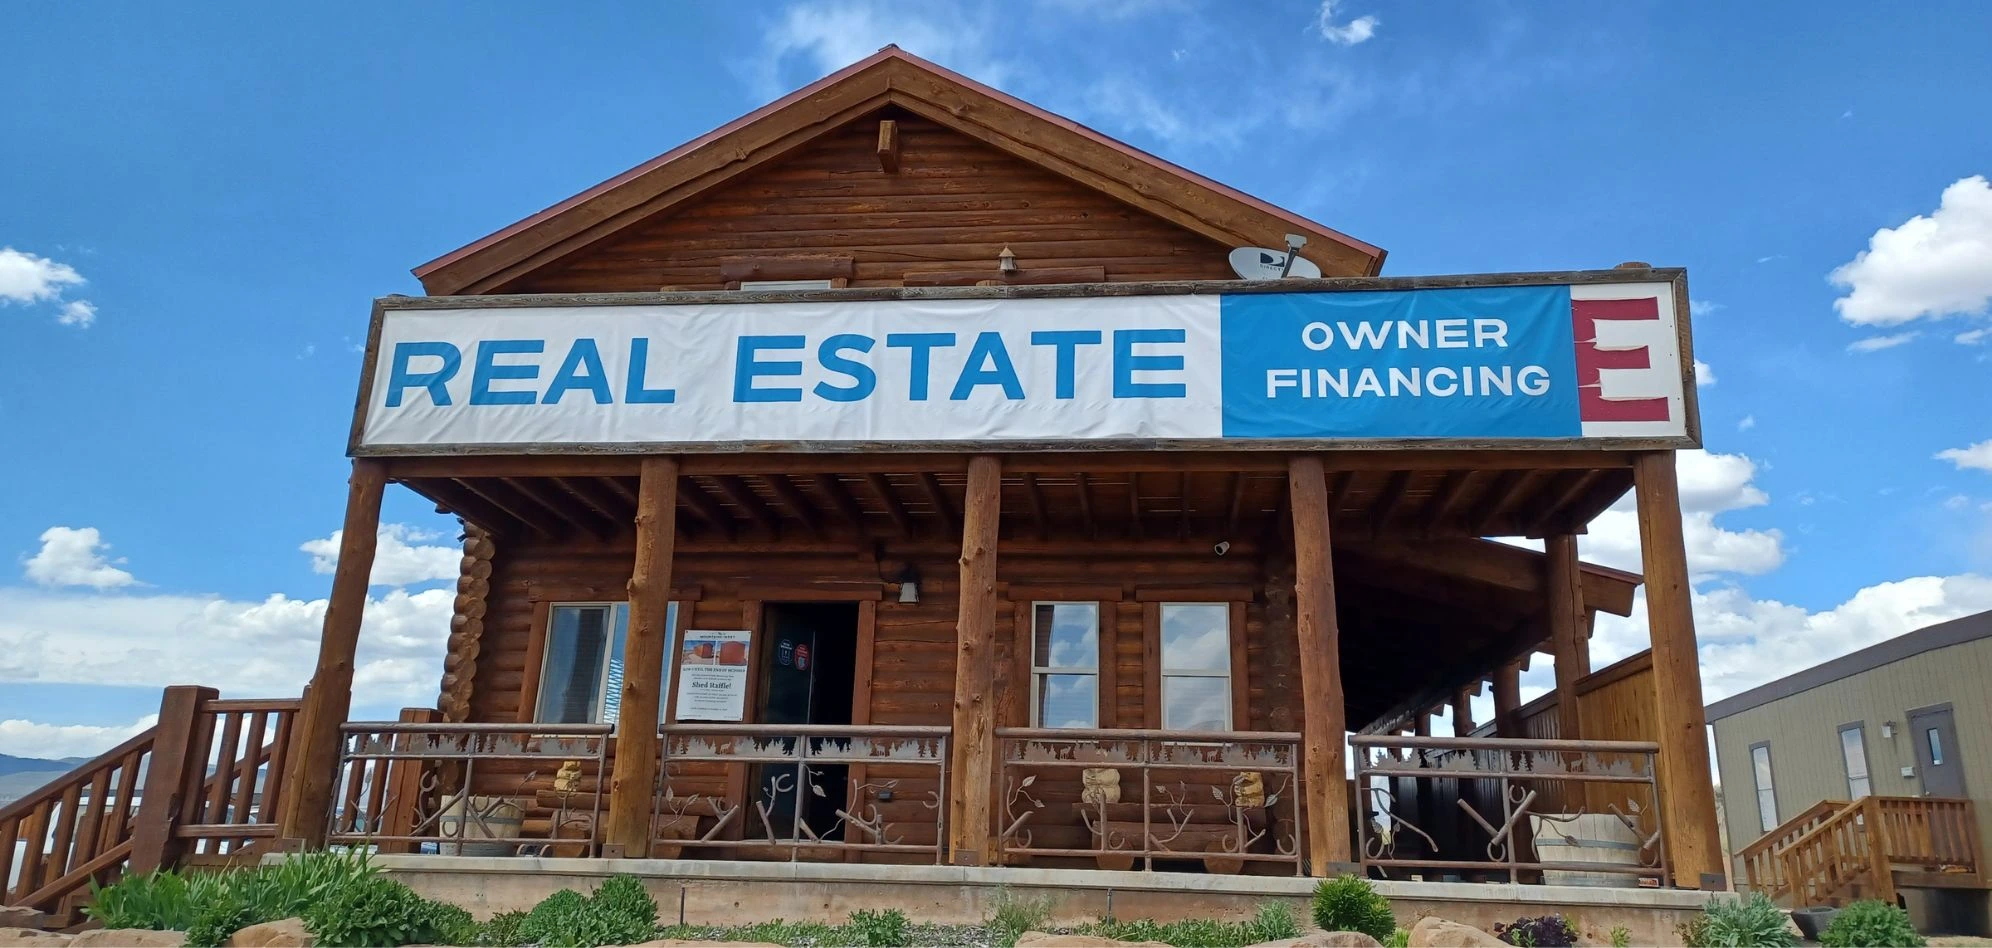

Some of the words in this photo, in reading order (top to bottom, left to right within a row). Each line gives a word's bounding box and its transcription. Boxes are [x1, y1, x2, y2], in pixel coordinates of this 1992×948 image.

[1302, 319, 1508, 350] OWNER
[1573, 297, 1670, 422] E
[385, 337, 676, 408] REAL
[733, 329, 1187, 403] ESTATE
[1267, 365, 1550, 398] FINANCING
